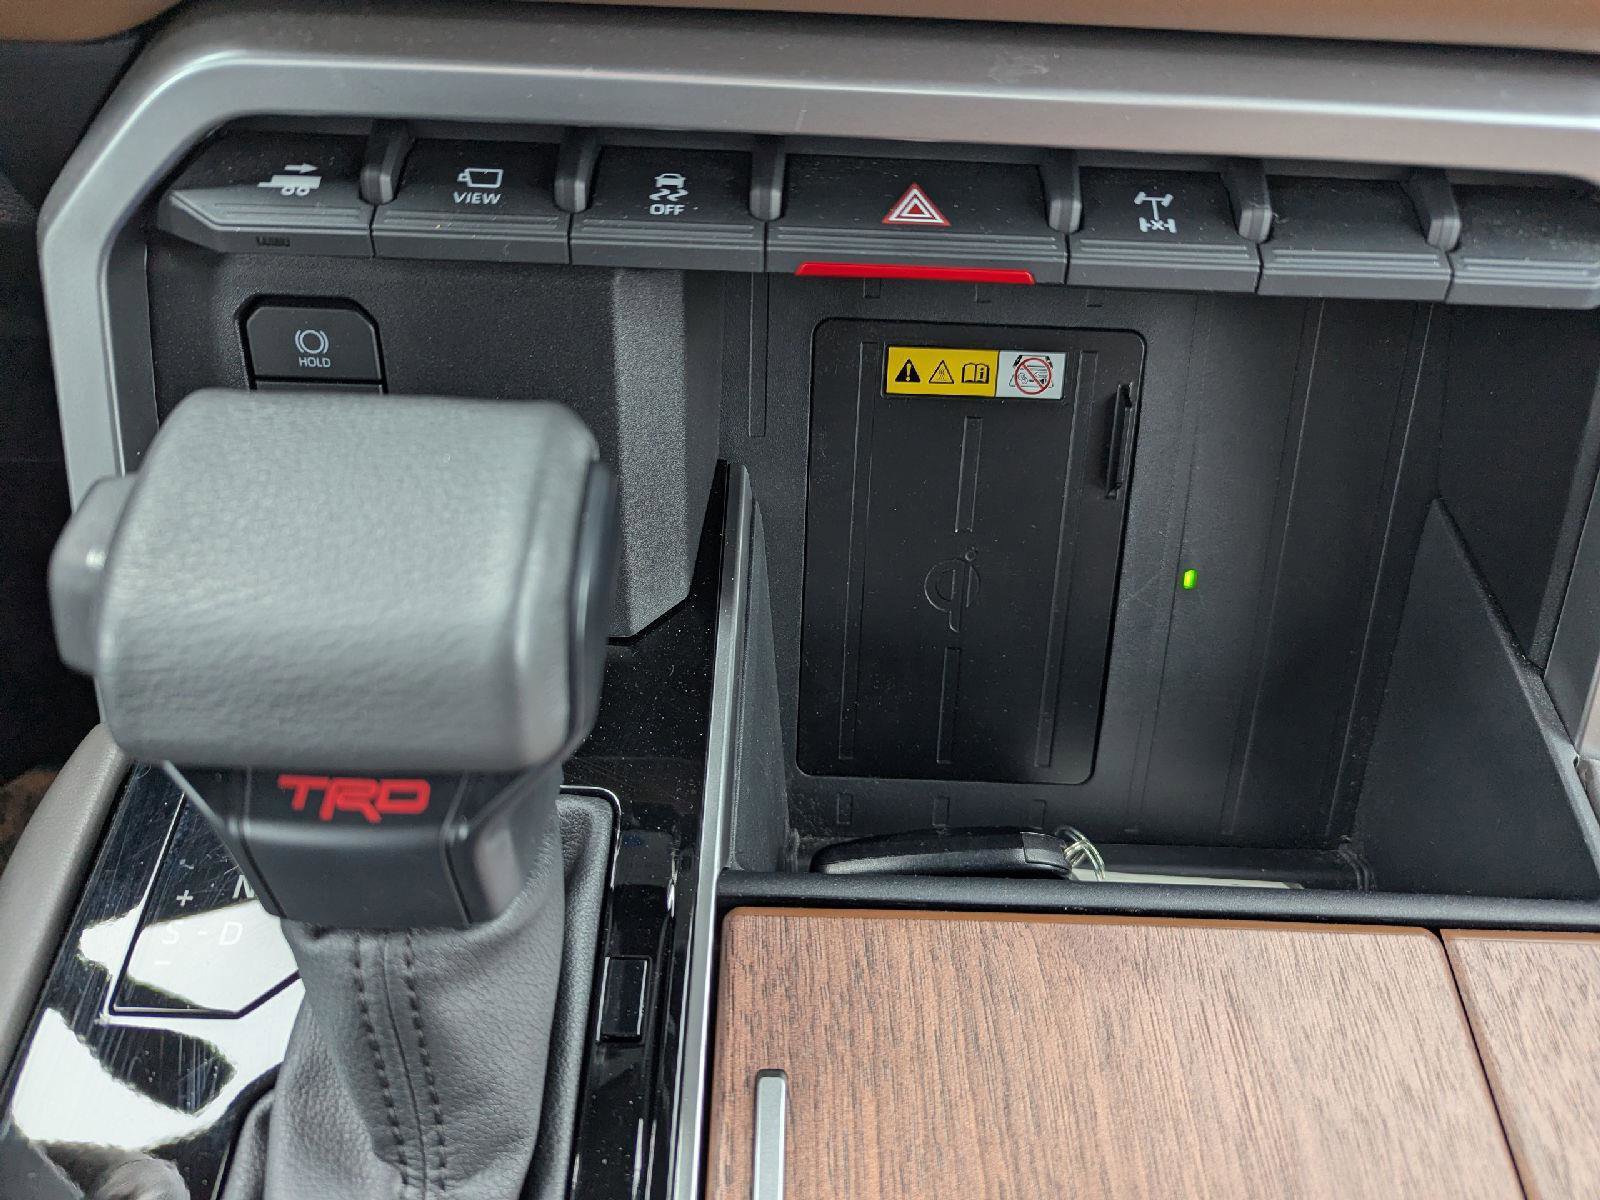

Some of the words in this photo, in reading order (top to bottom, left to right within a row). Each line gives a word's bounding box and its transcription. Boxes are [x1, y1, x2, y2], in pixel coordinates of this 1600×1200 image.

[453, 191, 502, 205] VIEW
[649, 204, 685, 215] OFF
[299, 357, 331, 369] HOLD
[278, 775, 431, 823] TRD
[162, 920, 183, 944] S
[218, 921, 243, 945] D
